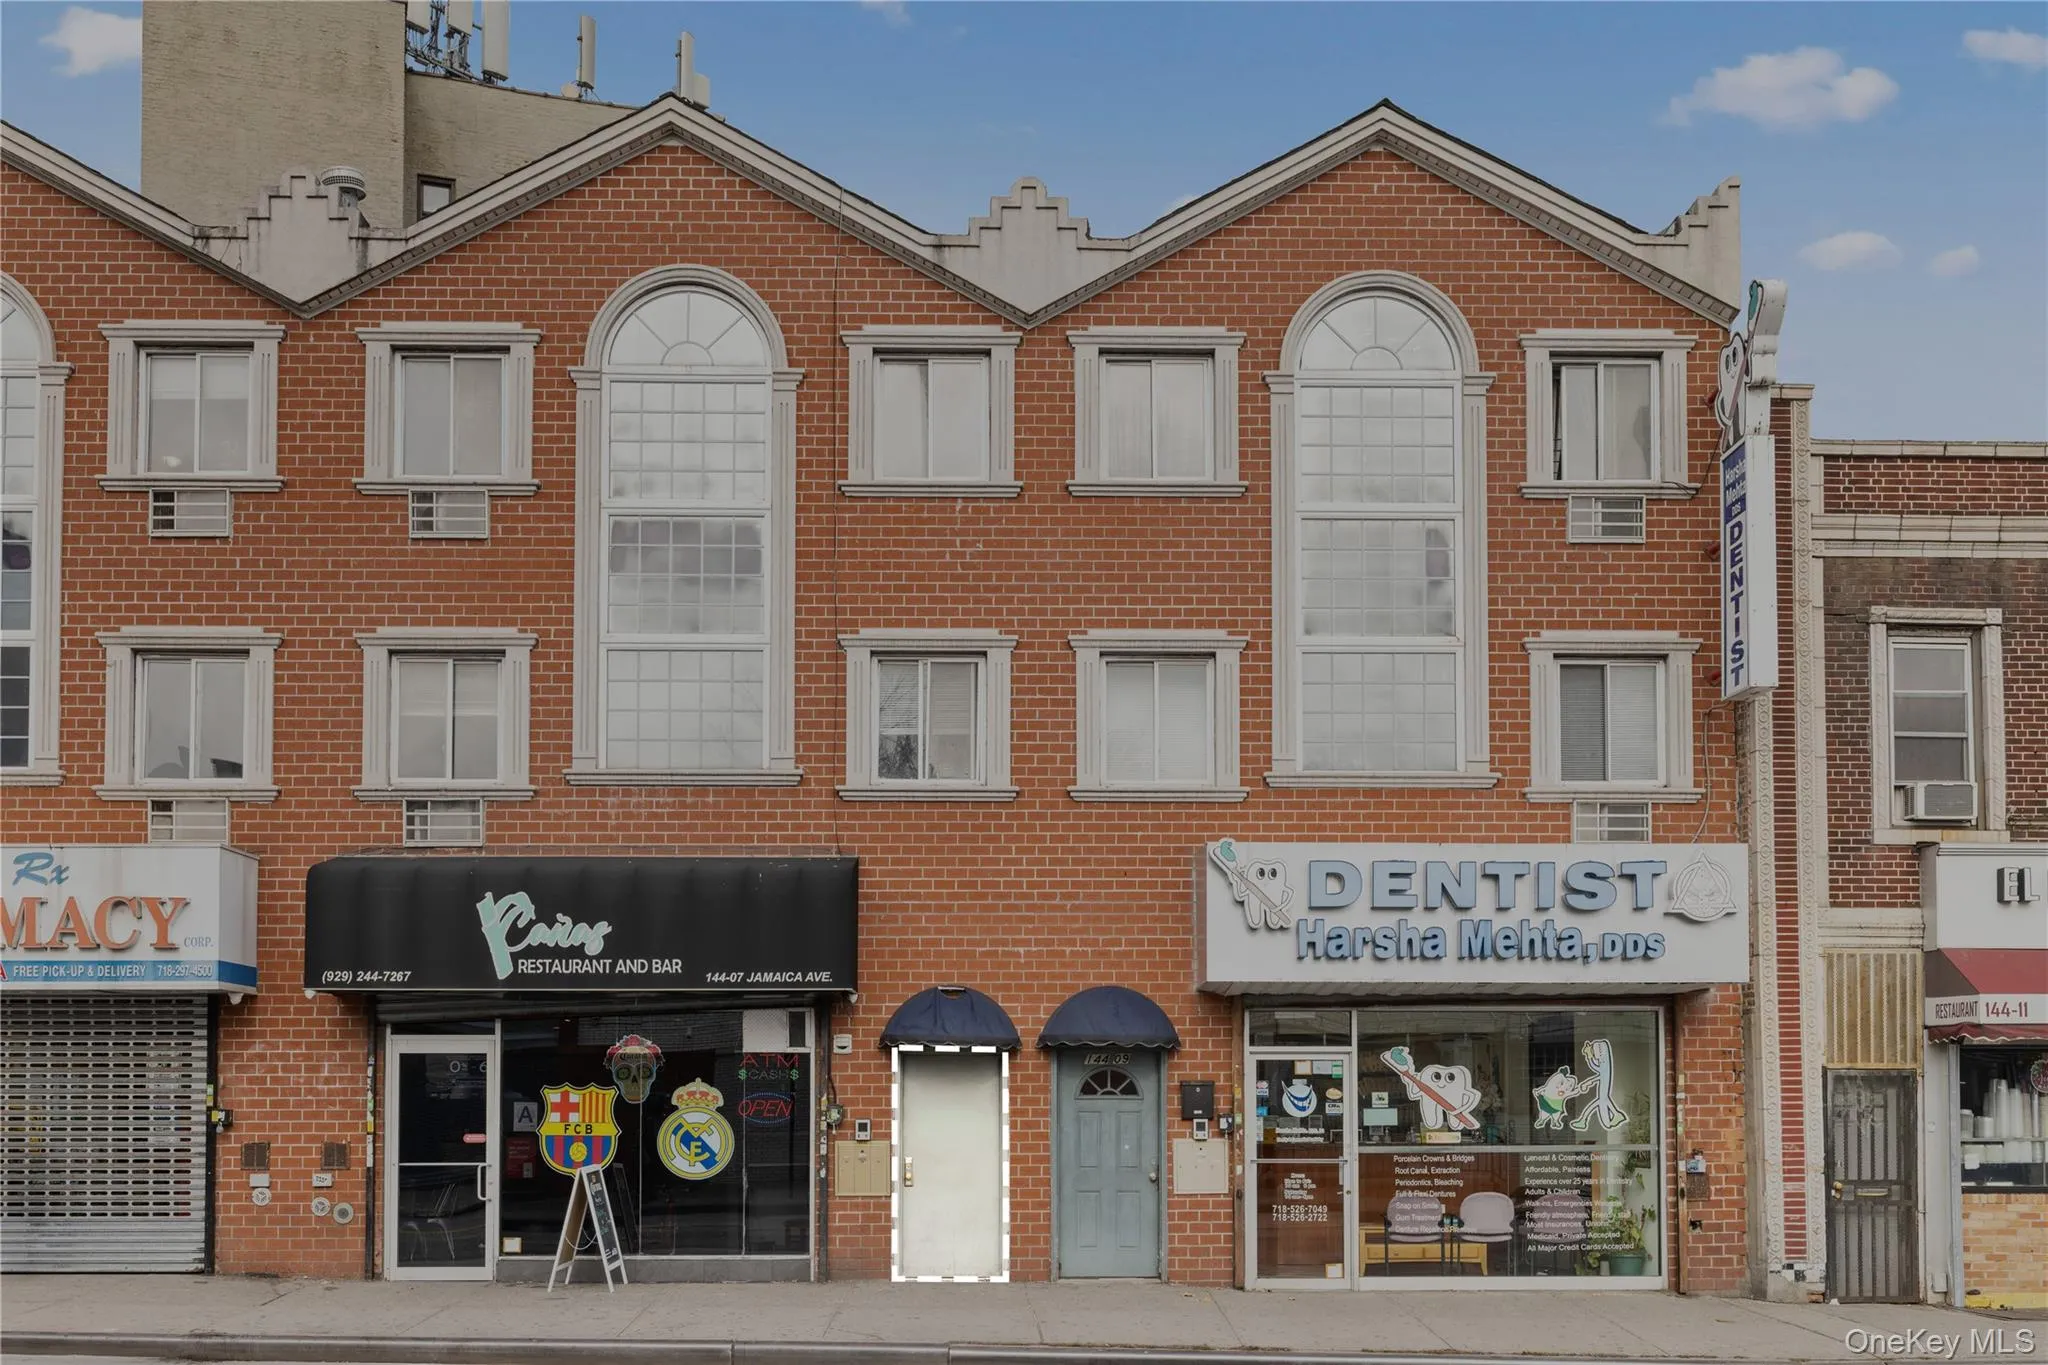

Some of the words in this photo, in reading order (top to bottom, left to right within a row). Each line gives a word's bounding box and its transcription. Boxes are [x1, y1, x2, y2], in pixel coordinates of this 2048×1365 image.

[1729, 520, 1745, 687] DENTIST
[12, 851, 71, 886] Rx
[1308, 859, 1667, 910] DENTIST
[1996, 867, 2040, 904] EL
[184, 935, 214, 948] CORP.
[1297, 918, 1448, 960] Harsha
[13, 965, 39, 977] FREE
[42, 965, 84, 977] PICK-UP
[87, 965, 94, 977] &
[97, 965, 147, 977] DELIVERY
[518, 959, 612, 974] RESTAURANT
[615, 959, 648, 974] AND
[652, 959, 682, 974] BAR
[322, 970, 353, 984] (929)
[357, 970, 411, 983] 244-7267
[705, 971, 744, 983] 144-07
[746, 971, 802, 982] JAMAICA
[804, 971, 833, 982] AVE.
[1935, 1001, 1979, 1019] RESTAURANT
[1985, 1001, 2028, 1017] 144-11
[739, 1053, 800, 1068] ATM
[518, 1105, 533, 1124] A
[738, 1100, 793, 1117] OPEN
[1393, 1155, 1421, 1163] Porcelain
[1452, 1154, 1475, 1163] Bridges
[1434, 1178, 1464, 1187] Bleaching
[1524, 1178, 1557, 1186] Experience
[1573, 1177, 1582, 1185] 25
[1272, 1205, 1328, 1213] 718-526-7049
[1272, 1213, 1328, 1222] 718-526-2722
[1538, 1244, 1557, 1253] Major
